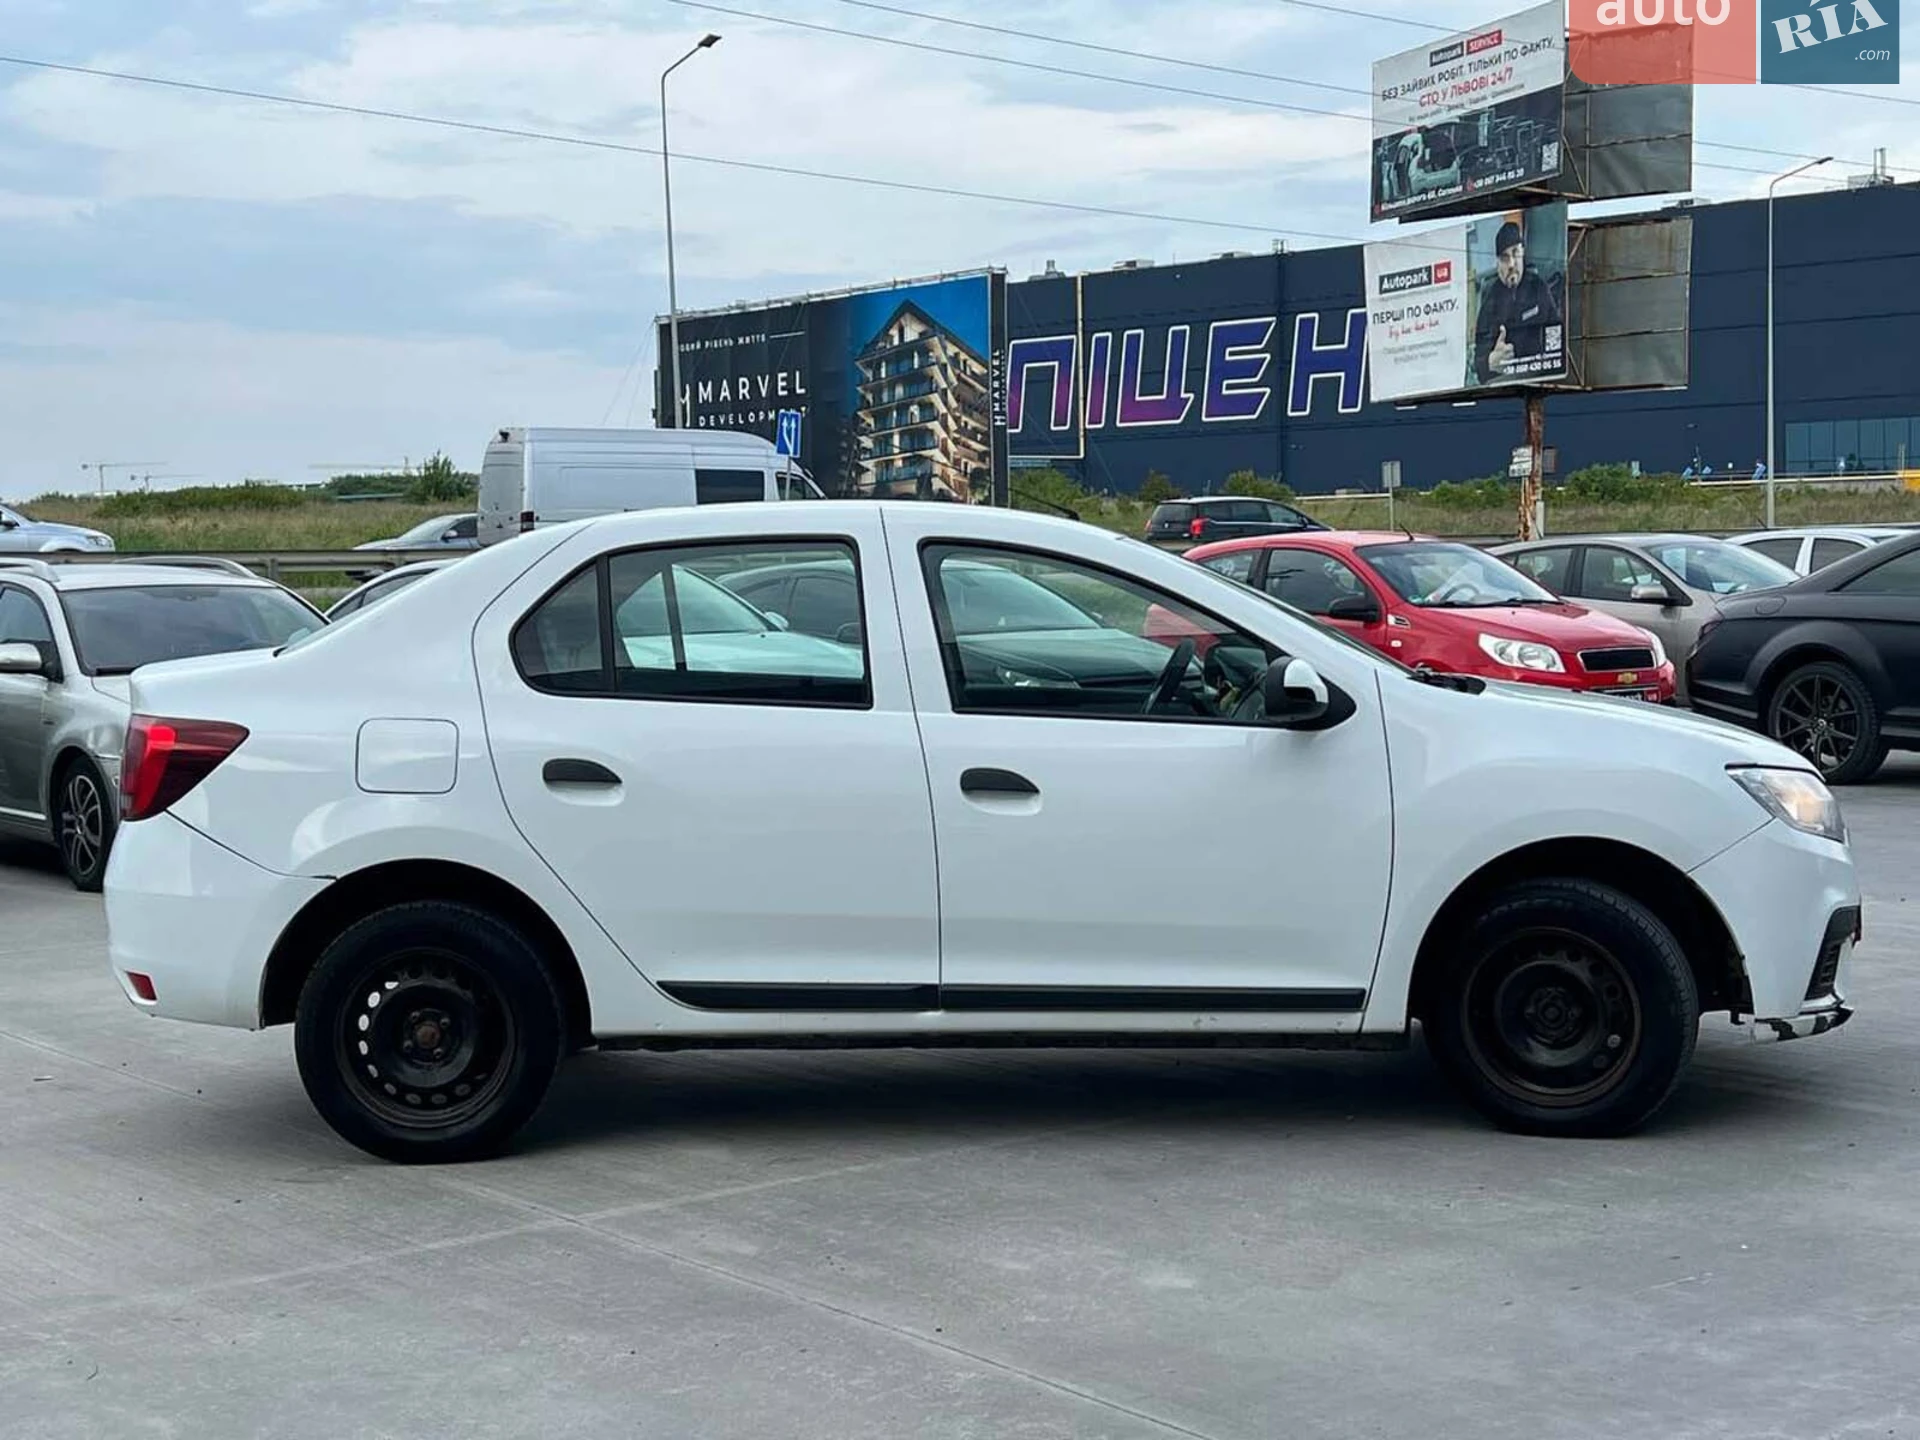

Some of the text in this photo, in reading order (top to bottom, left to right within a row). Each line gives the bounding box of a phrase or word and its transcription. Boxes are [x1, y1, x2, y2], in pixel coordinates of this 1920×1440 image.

[1382, 86, 1399, 102] БЕЗ
[1400, 75, 1436, 96] ЗАЙВИХ
[1468, 56, 1501, 74] ТІЛЬКИ
[1504, 48, 1518, 62] ПО
[1419, 90, 1440, 108] СТО
[1440, 89, 1448, 104] У
[1450, 77, 1489, 100] ЛЬВОВІ
[1491, 67, 1514, 86] 24/7
[1381, 268, 1430, 292] Autopark
[1373, 308, 1405, 325] ПЕРШІ
[1407, 306, 1421, 319] ПО
[698, 370, 806, 404] MARVEL
[698, 406, 807, 428] DEVELOPMT
